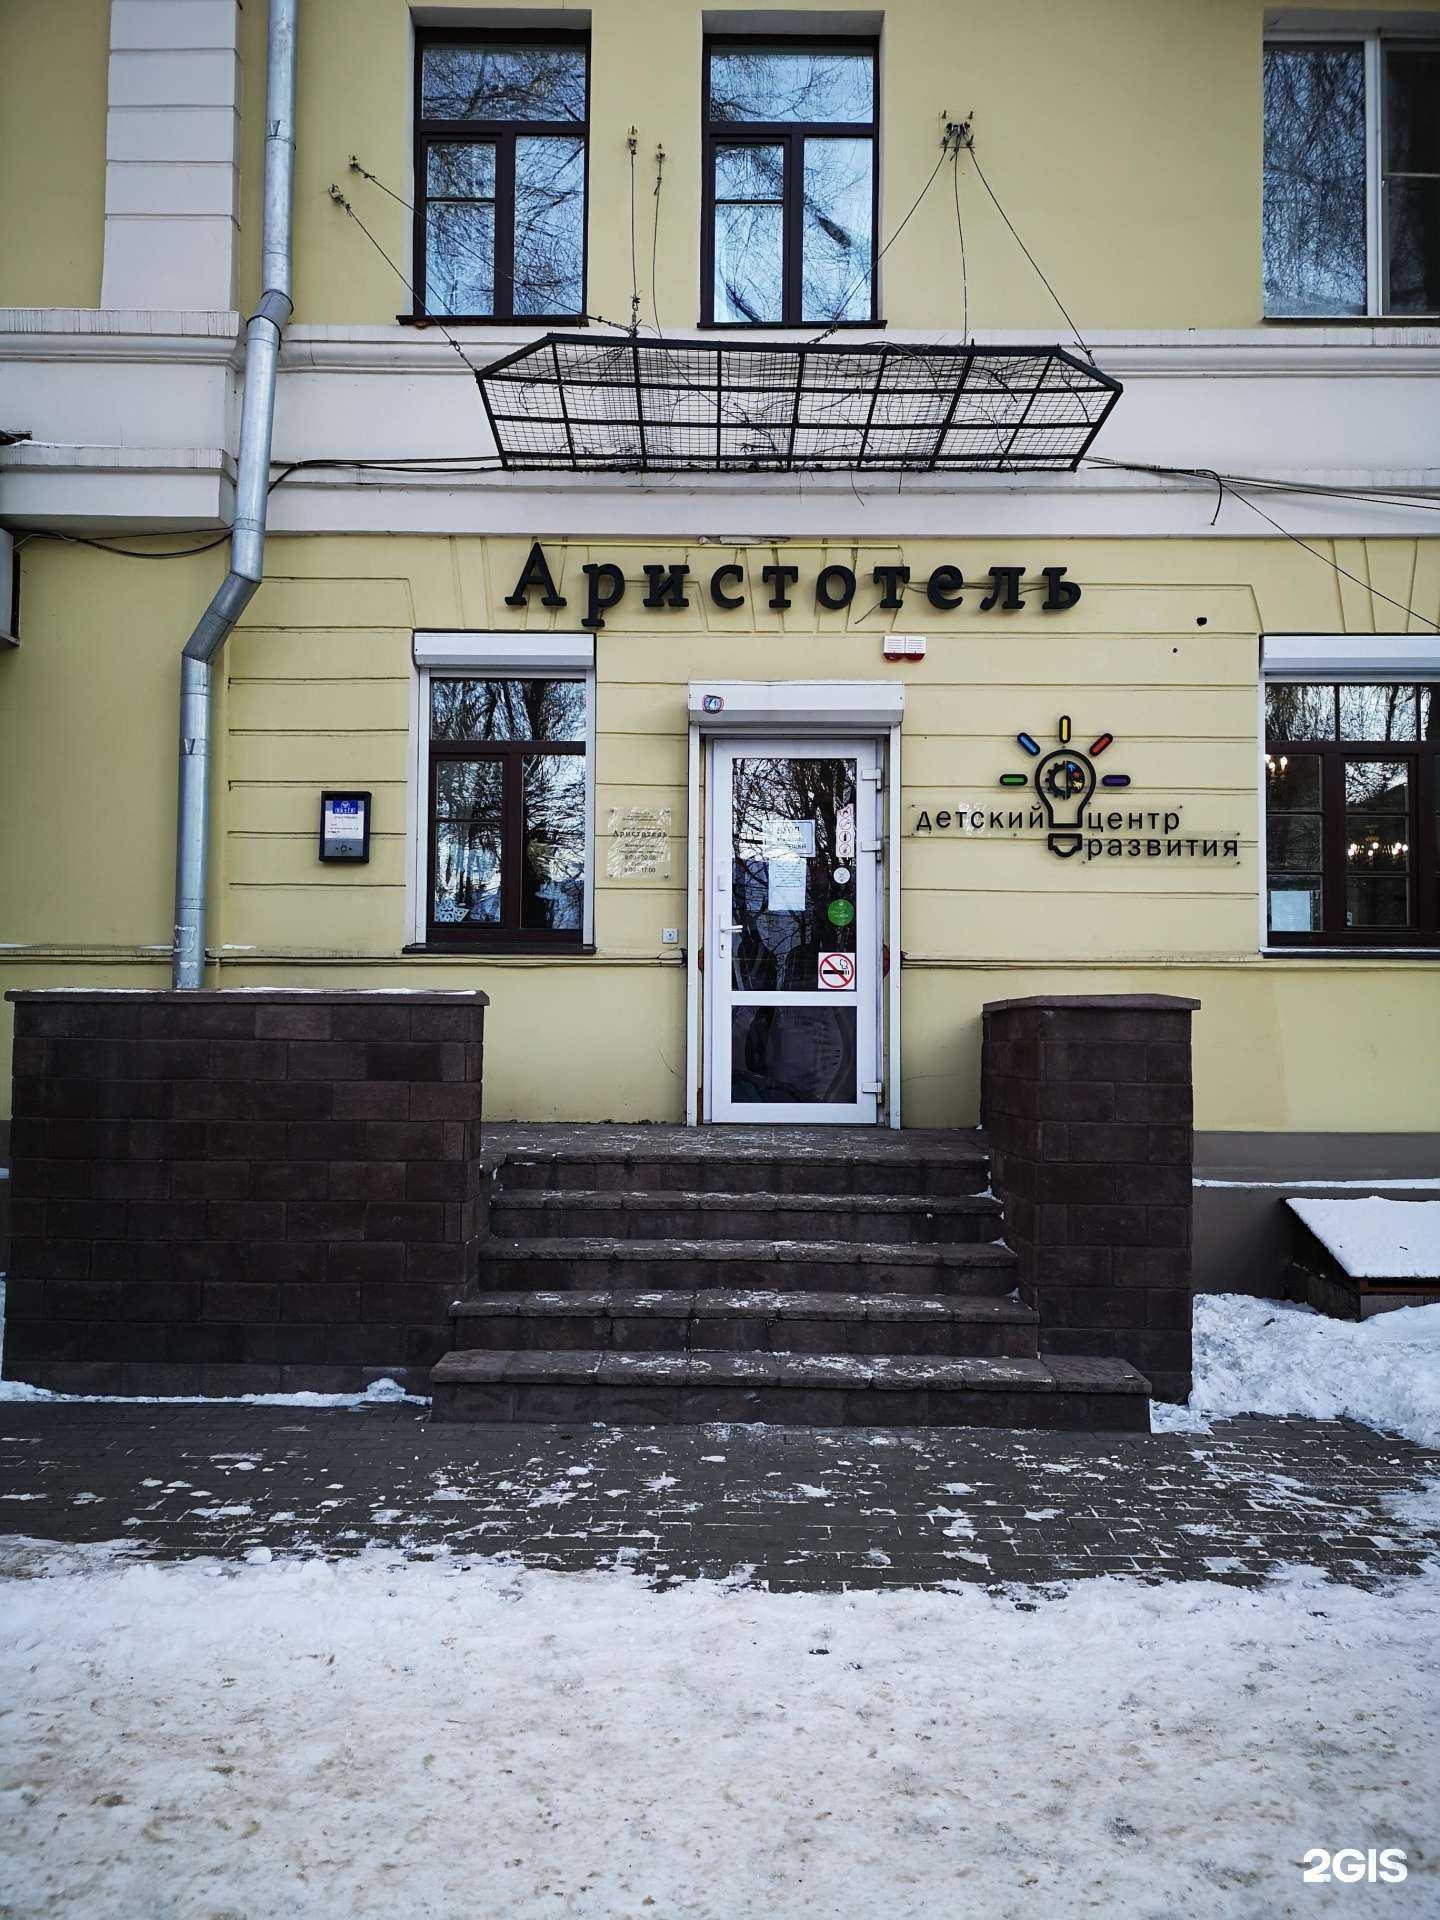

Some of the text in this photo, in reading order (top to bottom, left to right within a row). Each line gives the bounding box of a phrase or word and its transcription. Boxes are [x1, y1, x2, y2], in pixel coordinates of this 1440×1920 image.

[504, 542, 1083, 628] Аристотель
[916, 805, 1180, 834] детский центр
[1087, 837, 1239, 860] развития
